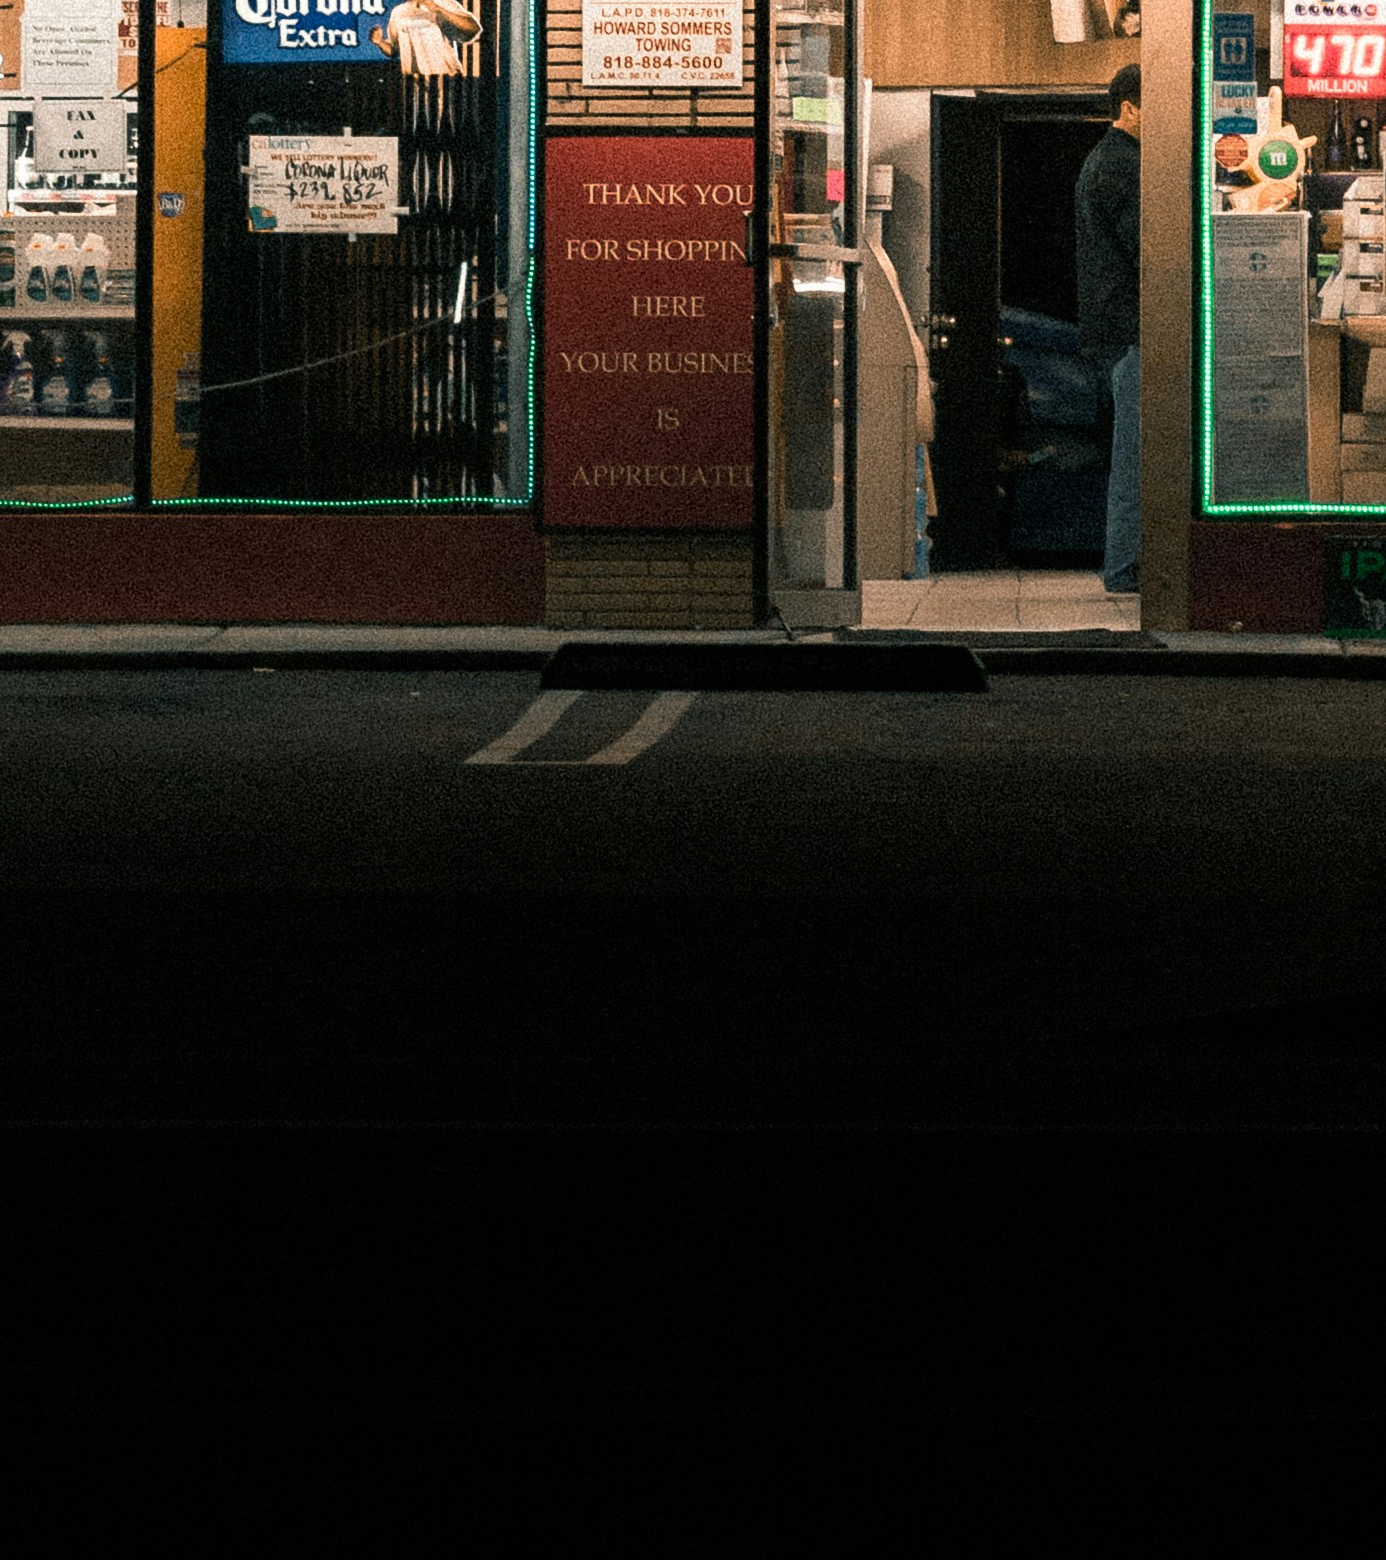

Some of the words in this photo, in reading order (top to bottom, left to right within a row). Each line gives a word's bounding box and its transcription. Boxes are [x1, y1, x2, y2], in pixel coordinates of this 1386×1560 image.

[278, 18, 358, 48] Extra
[593, 22, 657, 36] HOWARD
[660, 22, 733, 36] SOMMERS
[635, 38, 692, 53] TOWING
[1293, 34, 1386, 76] 470
[603, 56, 723, 70] 818-884-5600
[1307, 79, 1368, 93] MILLION
[67, 110, 96, 121] FAX
[59, 149, 100, 159] COPY
[583, 183, 688, 206] THANK
[694, 183, 754, 206] YOU
[565, 239, 621, 261] FOR
[626, 239, 748, 261] SHOPPIN
[631, 296, 706, 318] HERE
[560, 352, 639, 374] YOUR
[647, 352, 754, 374] BUSINES
[656, 408, 681, 430] IS
